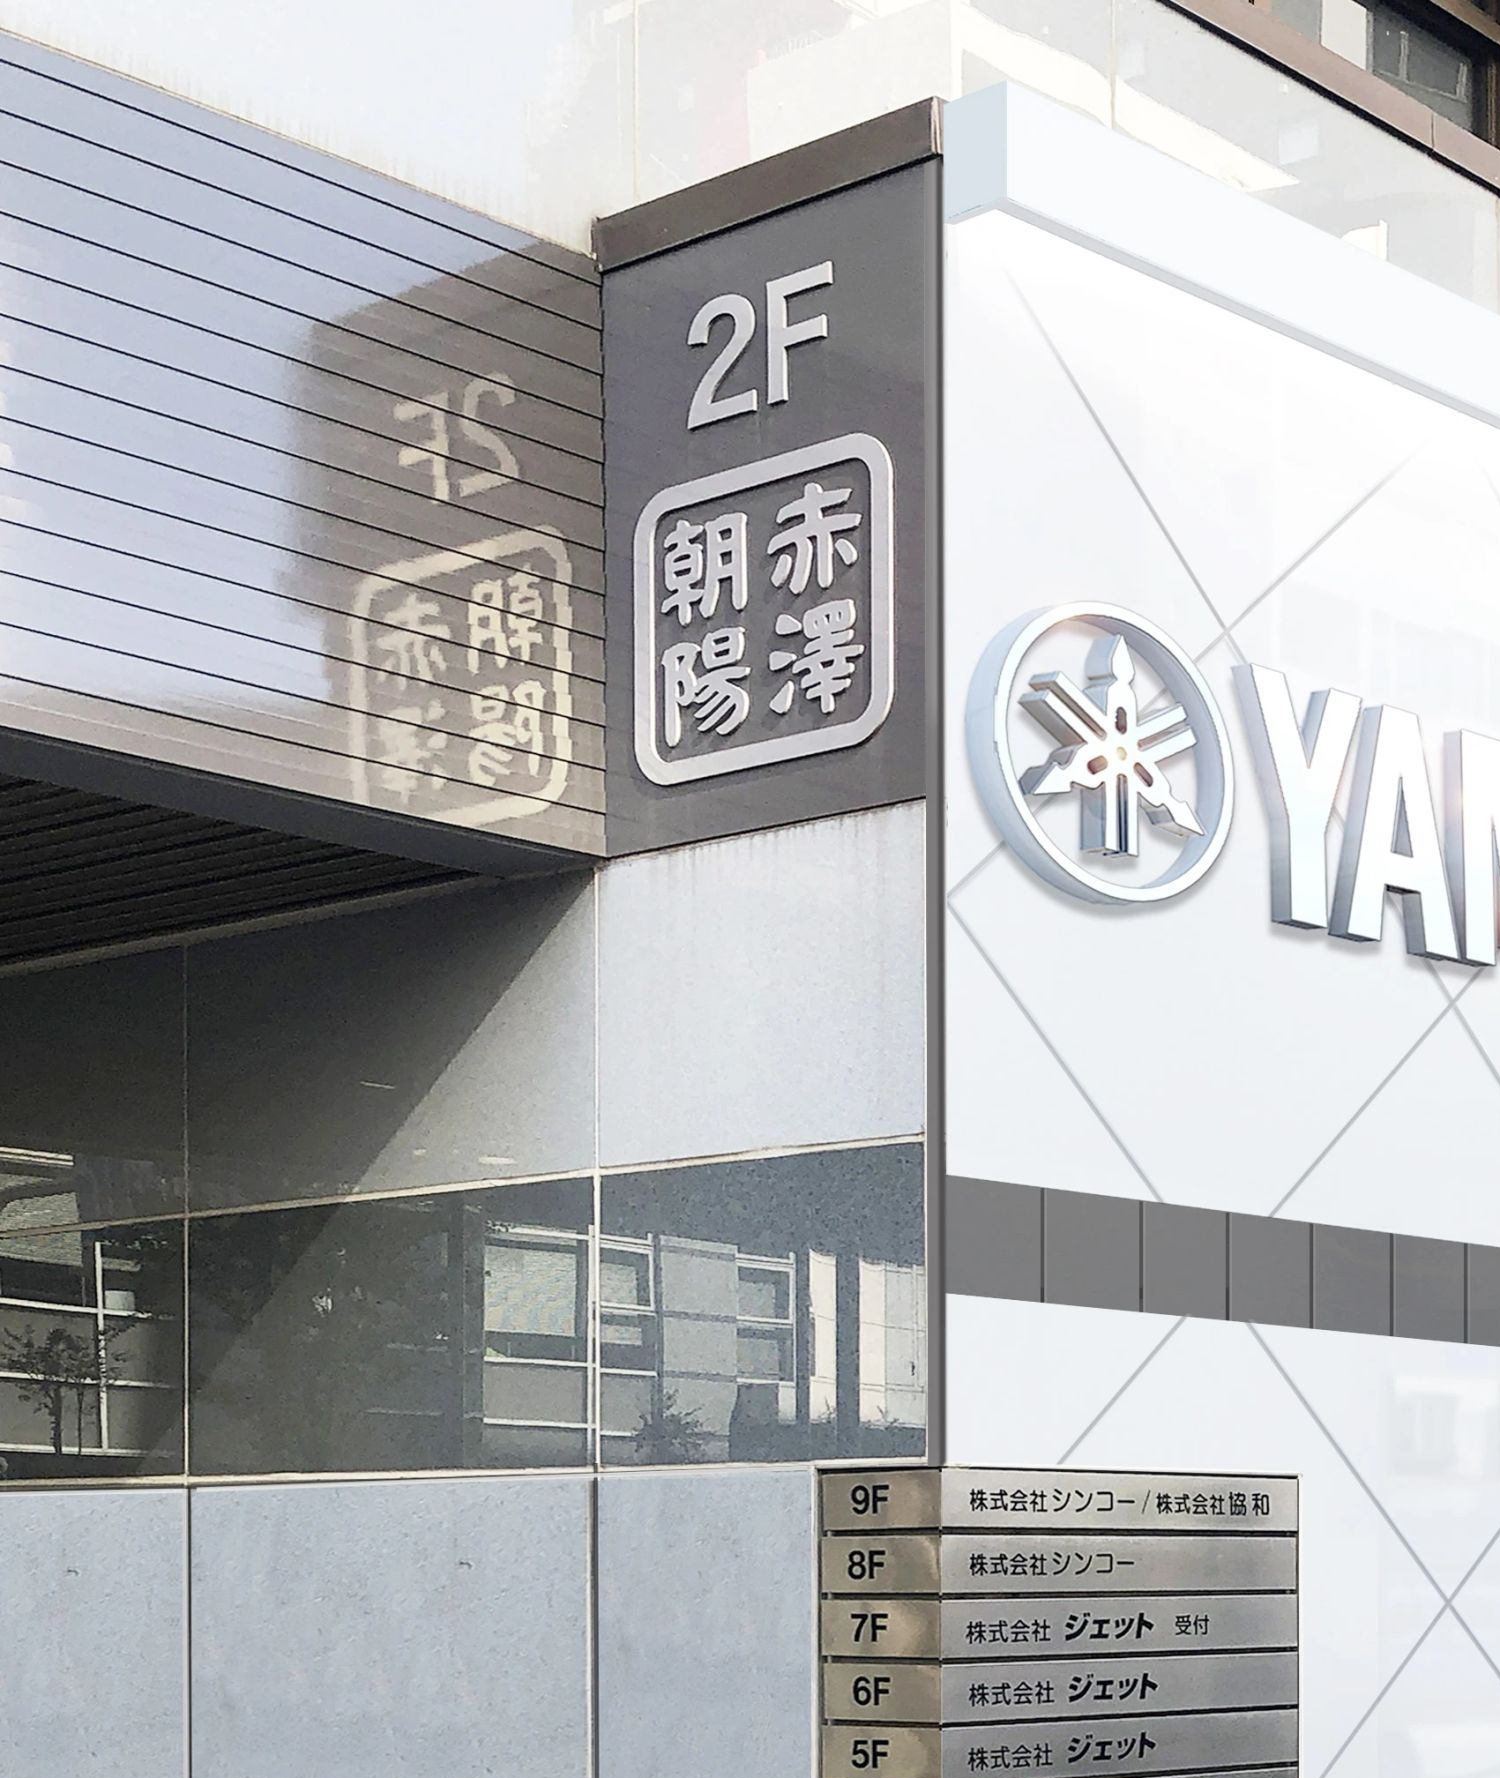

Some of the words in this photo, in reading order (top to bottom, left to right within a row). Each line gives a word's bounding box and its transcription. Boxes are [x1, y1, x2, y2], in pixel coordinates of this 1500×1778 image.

[687, 261, 834, 430] 2F
[767, 482, 864, 716] 赤澤
[661, 511, 751, 747] 朝陽
[851, 1484, 890, 1515] 9F
[969, 1488, 1136, 1514] 株式会社シンコー
[848, 1550, 886, 1580] 8F
[969, 1552, 1135, 1577] 株式会社シンコー
[851, 1613, 888, 1643] 7F
[966, 1620, 1051, 1645] 株式会社
[1064, 1612, 1154, 1641] ジェット
[1174, 1614, 1210, 1637] 受付
[853, 1676, 891, 1707] 6F
[968, 1681, 1054, 1706] 株式会社
[1068, 1672, 1158, 1702] ジェット
[851, 1739, 889, 1769] 5F
[968, 1744, 1053, 1770] 株式会社
[1067, 1732, 1156, 1764] ジェット
